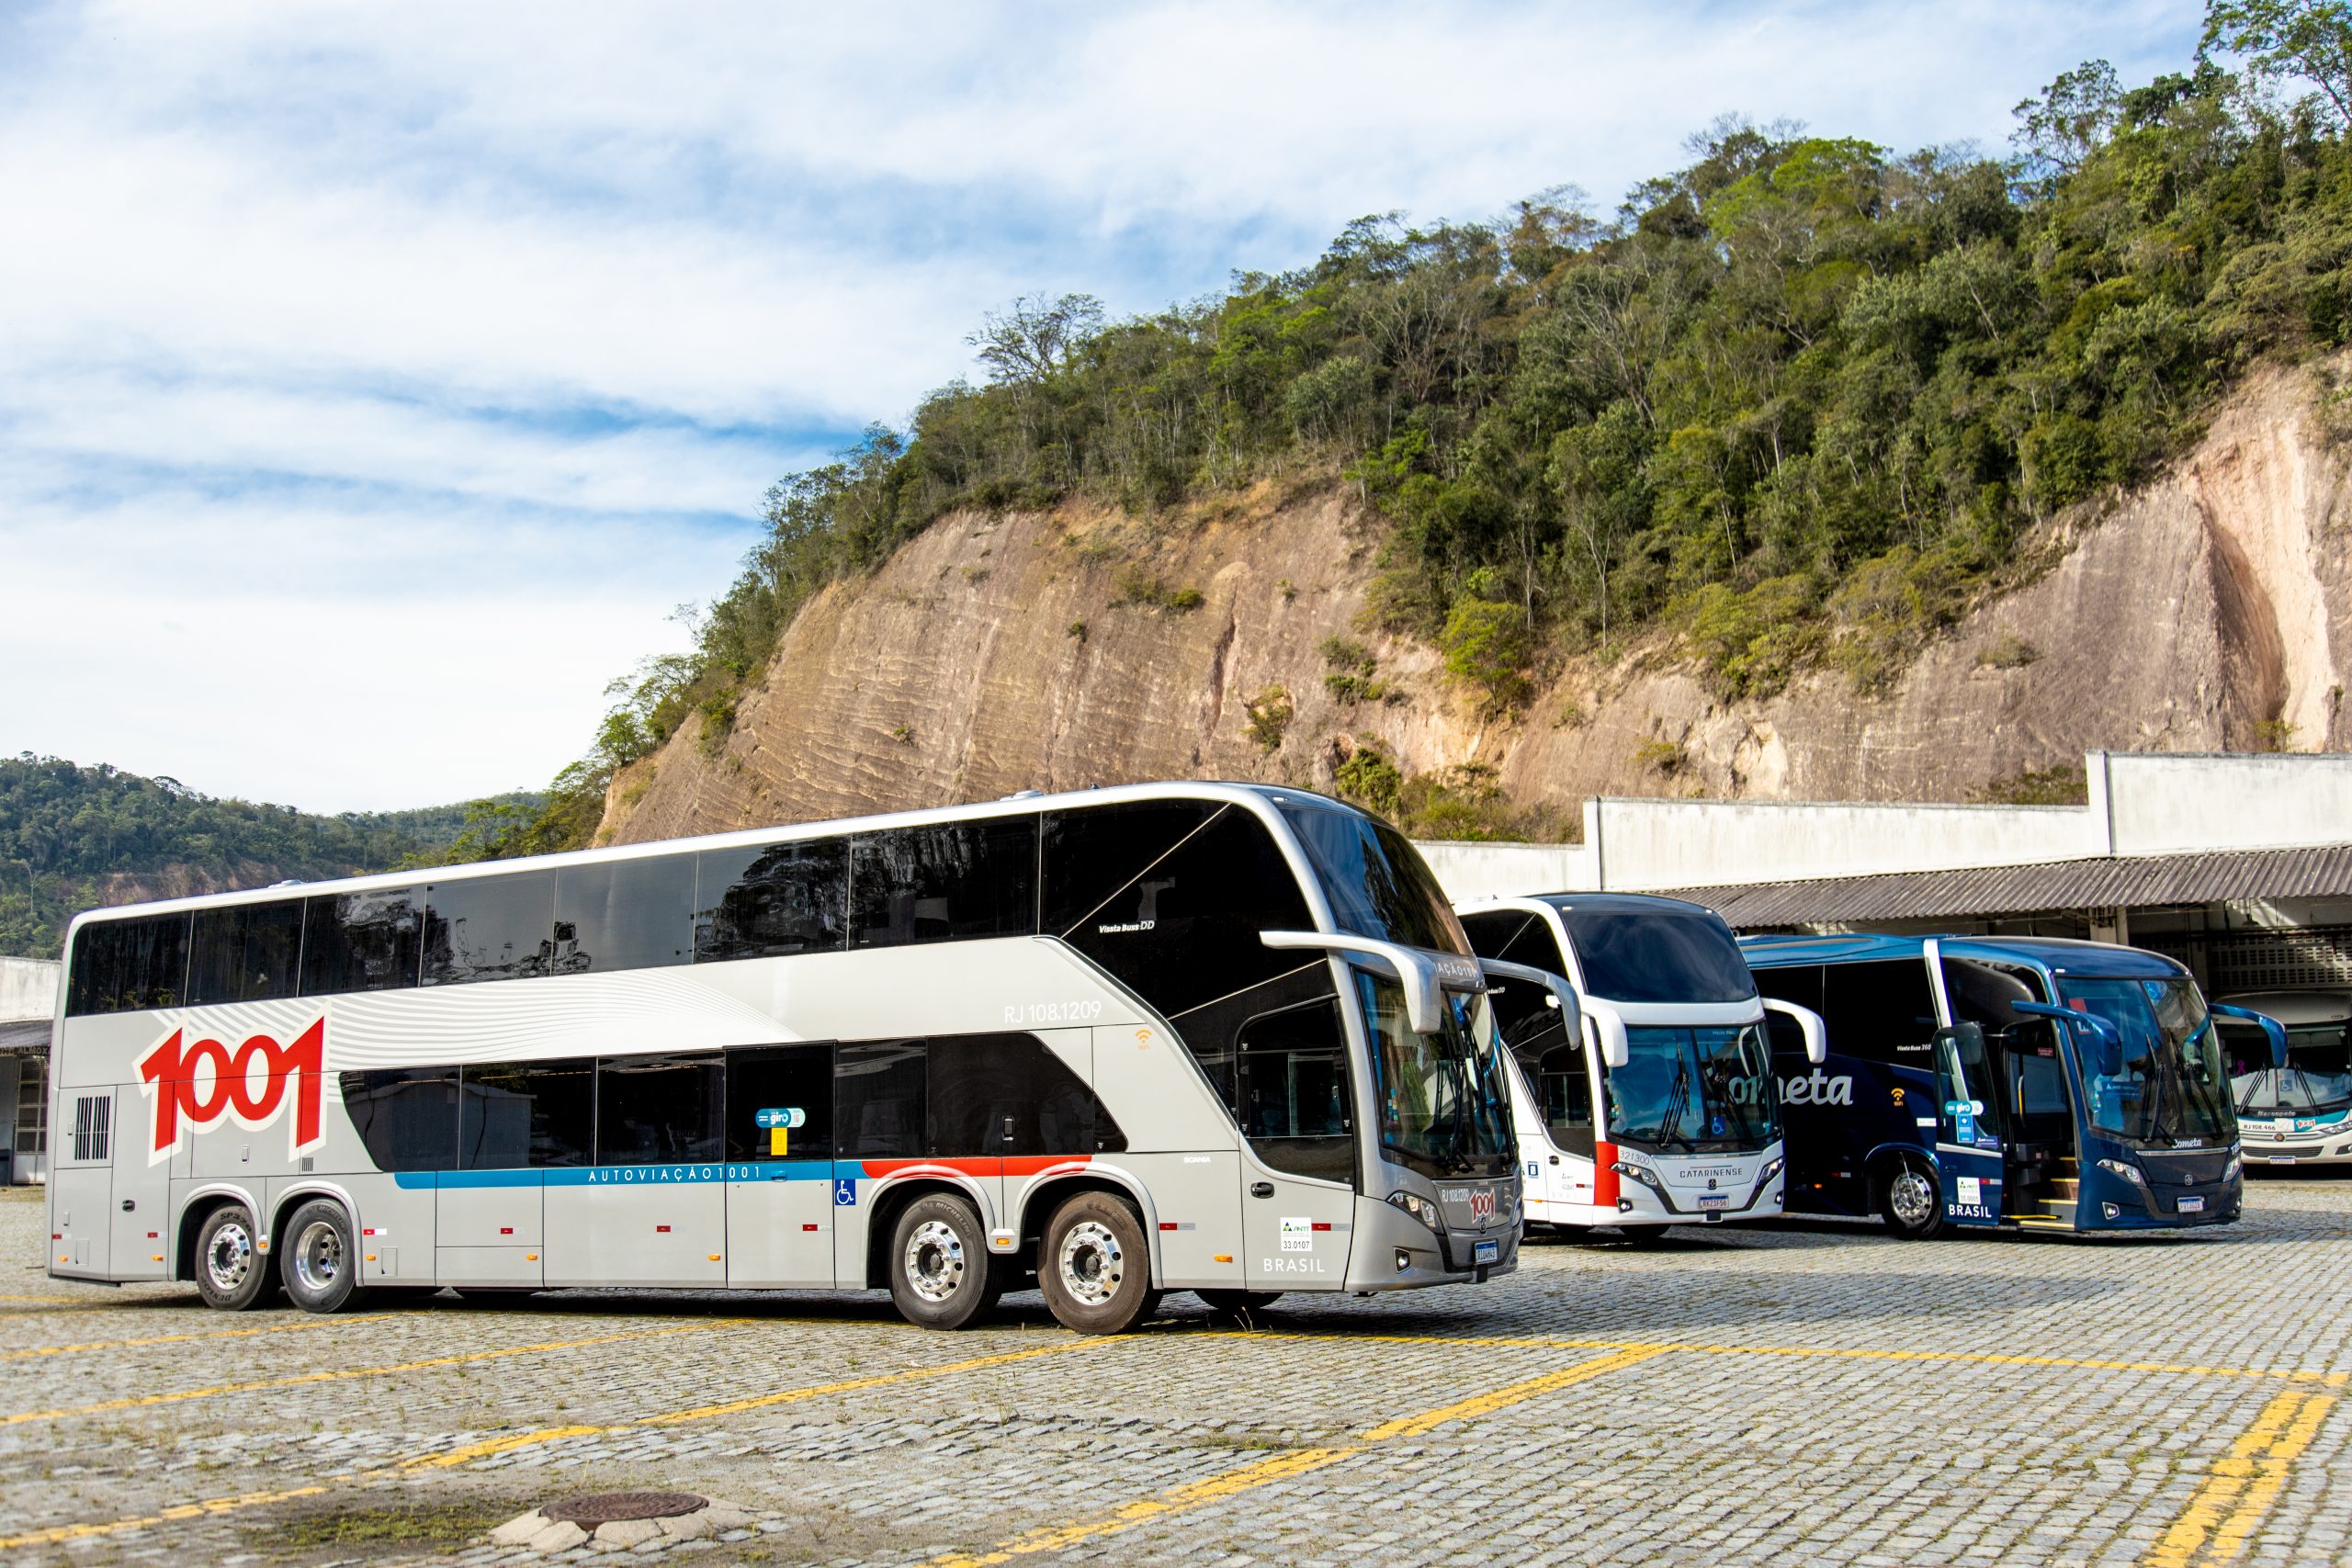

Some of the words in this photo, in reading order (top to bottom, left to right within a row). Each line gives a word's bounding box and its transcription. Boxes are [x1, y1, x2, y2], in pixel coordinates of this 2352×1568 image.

[1099, 924, 1121, 933] Vissta
[1122, 923, 1139, 931] Buss
[1140, 920, 1155, 930] DD
[1005, 1006, 1023, 1023] RJ
[1028, 1000, 1102, 1022] 108.1209
[136, 1008, 328, 1159] 1001
[770, 1111, 789, 1124] giro
[2171, 1138, 2202, 1149] Cometa
[1619, 1150, 1650, 1166] 321300
[1679, 1168, 1743, 1179] CATARINENSE
[1470, 1190, 1496, 1223] 1001
[1949, 1203, 1992, 1218] BRASIL
[935, 1202, 971, 1235] MICHELIN
[1283, 1240, 1310, 1249] 33.0107
[1263, 1258, 1325, 1272] BRASIL
